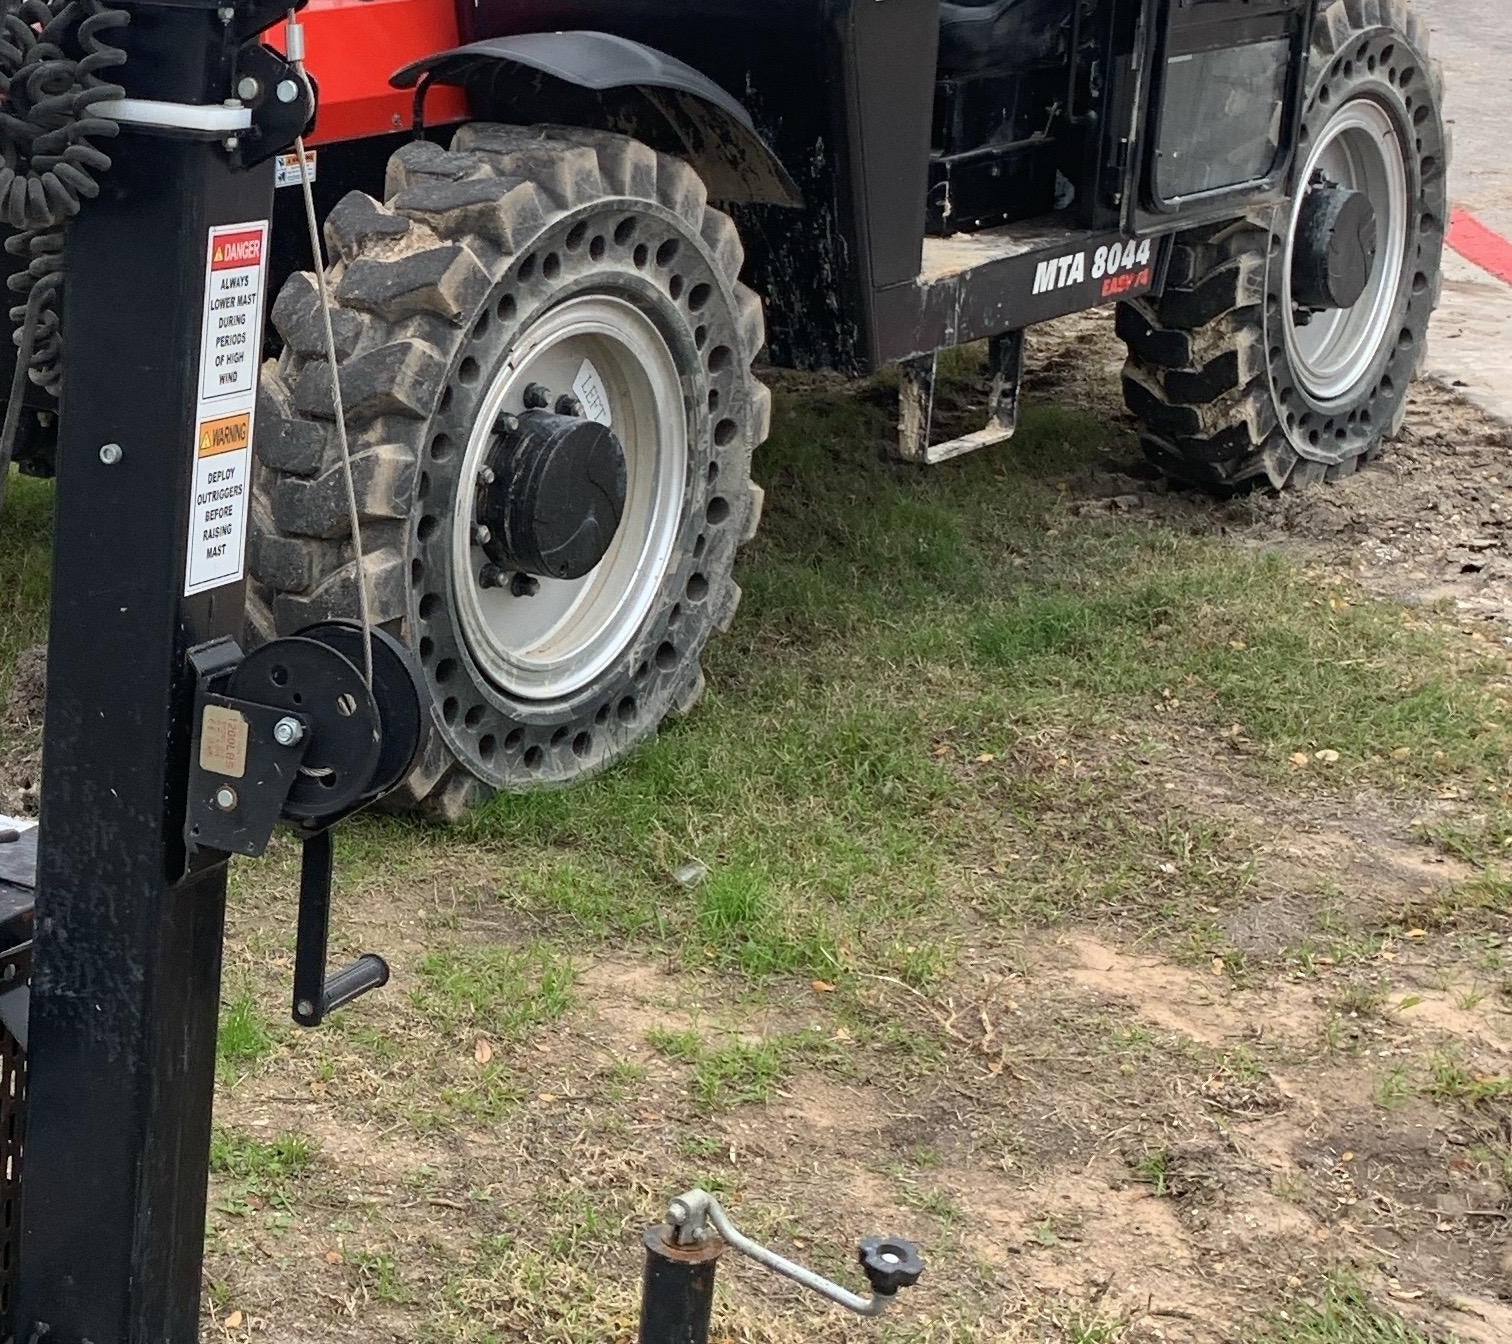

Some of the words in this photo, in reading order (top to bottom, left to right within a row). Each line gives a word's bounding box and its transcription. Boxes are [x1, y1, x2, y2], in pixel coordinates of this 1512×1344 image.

[223, 239, 260, 263] DANGER
[1032, 251, 1085, 295] MTA
[1091, 239, 1151, 279] 8044
[220, 275, 249, 290] ALWAYS
[210, 297, 236, 311] LOWER
[237, 293, 256, 306] MAST
[218, 313, 246, 329] DURING
[215, 333, 246, 349] PERIODS
[214, 355, 225, 367] OF
[226, 351, 244, 365] HIGH
[219, 371, 238, 385] WIND
[212, 422, 246, 448] WARNING
[207, 466, 235, 485] DEPLOY
[196, 484, 243, 506] OUTRIGGERS
[205, 505, 233, 523] BEFORE
[202, 523, 232, 542] RAISING
[206, 543, 226, 559] MAST
